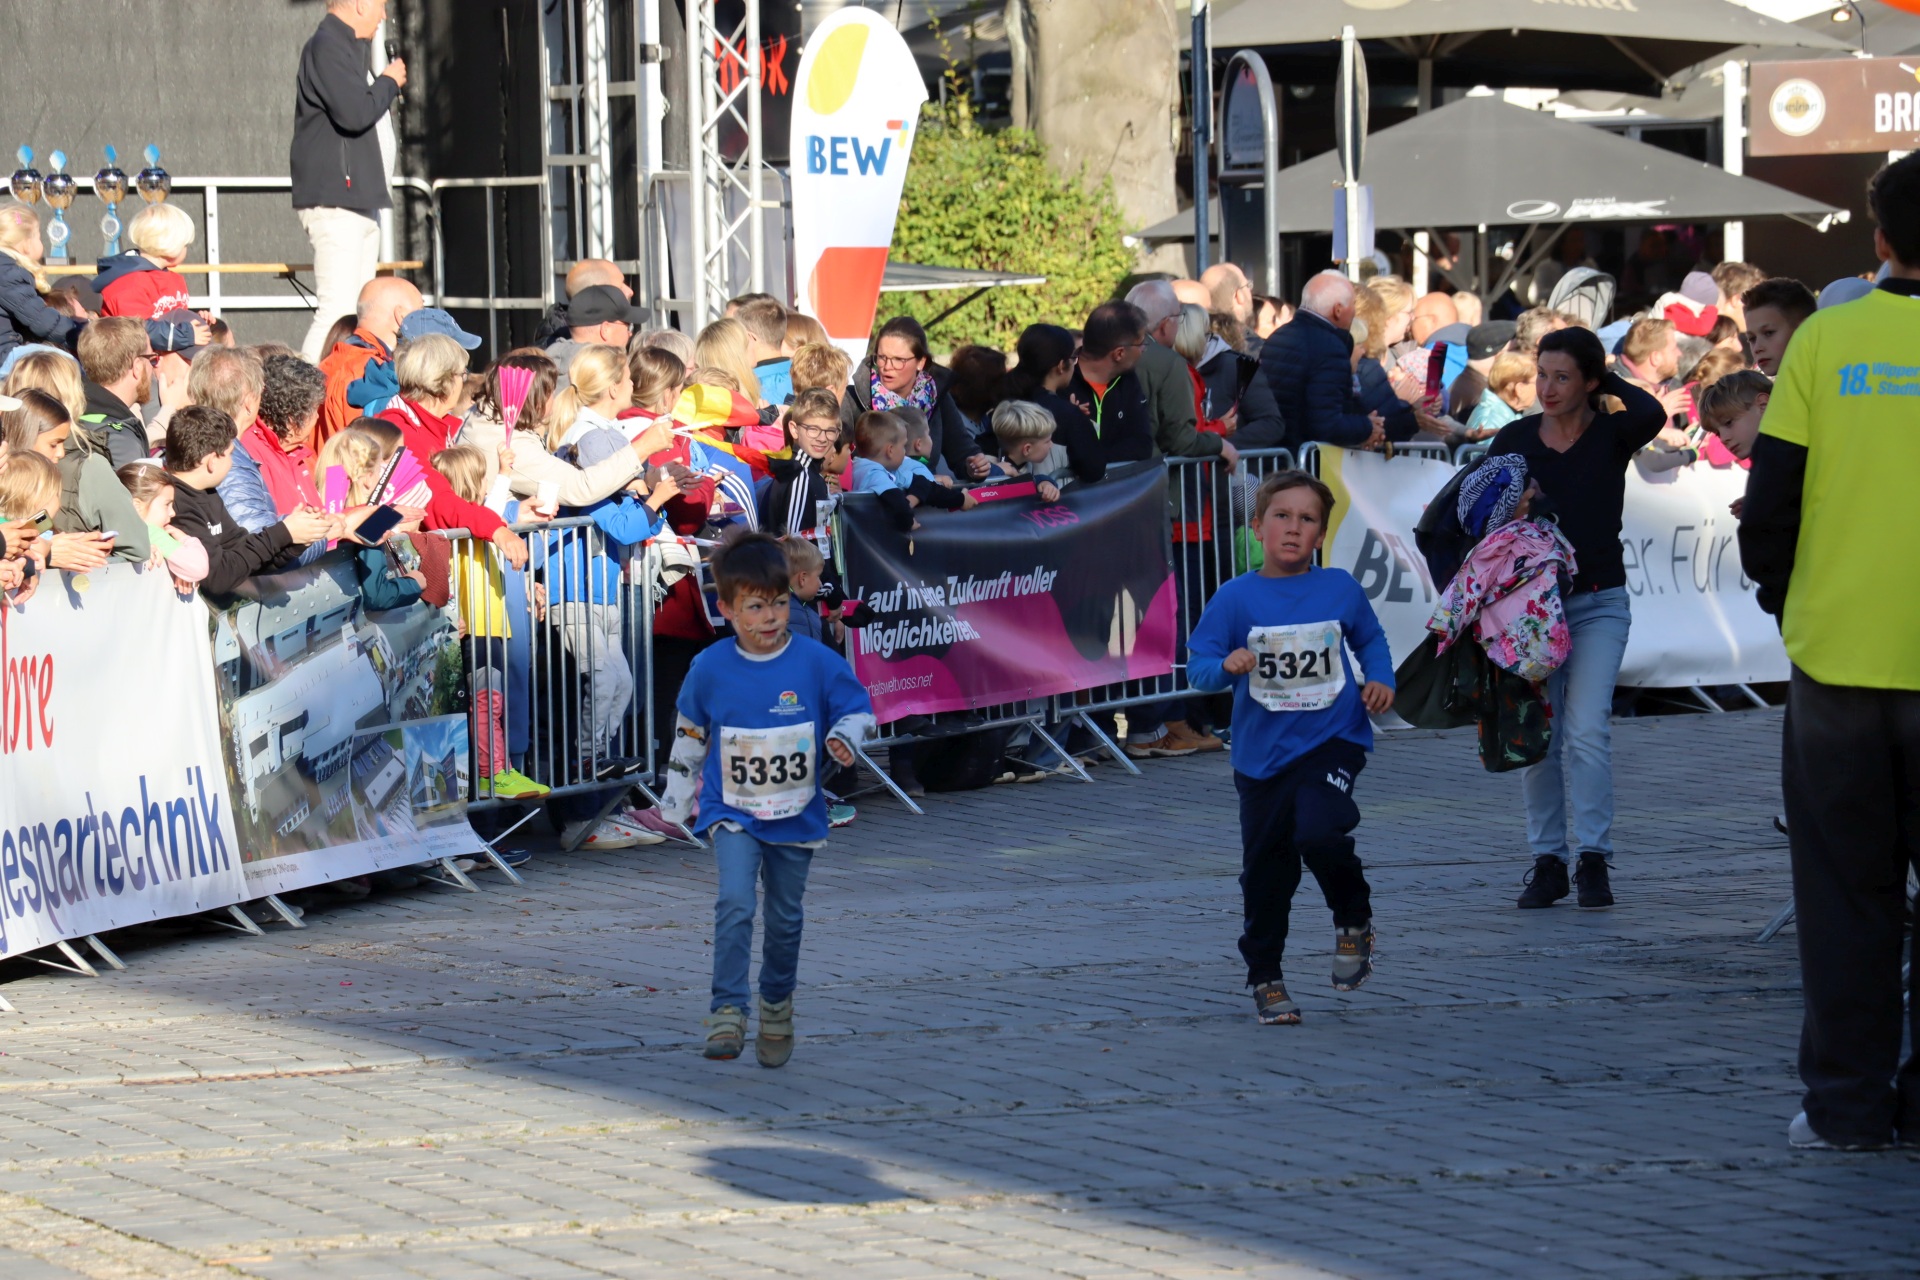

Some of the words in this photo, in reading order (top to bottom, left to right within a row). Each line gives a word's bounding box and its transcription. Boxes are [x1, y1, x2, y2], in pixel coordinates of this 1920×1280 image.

[805, 134, 892, 176] BEW
[1838, 362, 1873, 397] 18.
[1019, 505, 1080, 529] VOSS
[1671, 518, 1732, 594] Für
[947, 570, 1012, 606] Zukunft
[1013, 565, 1058, 597] voller
[858, 614, 980, 659] Möglichkeiten.
[1258, 647, 1331, 680] 5321
[731, 752, 808, 786] 5333
